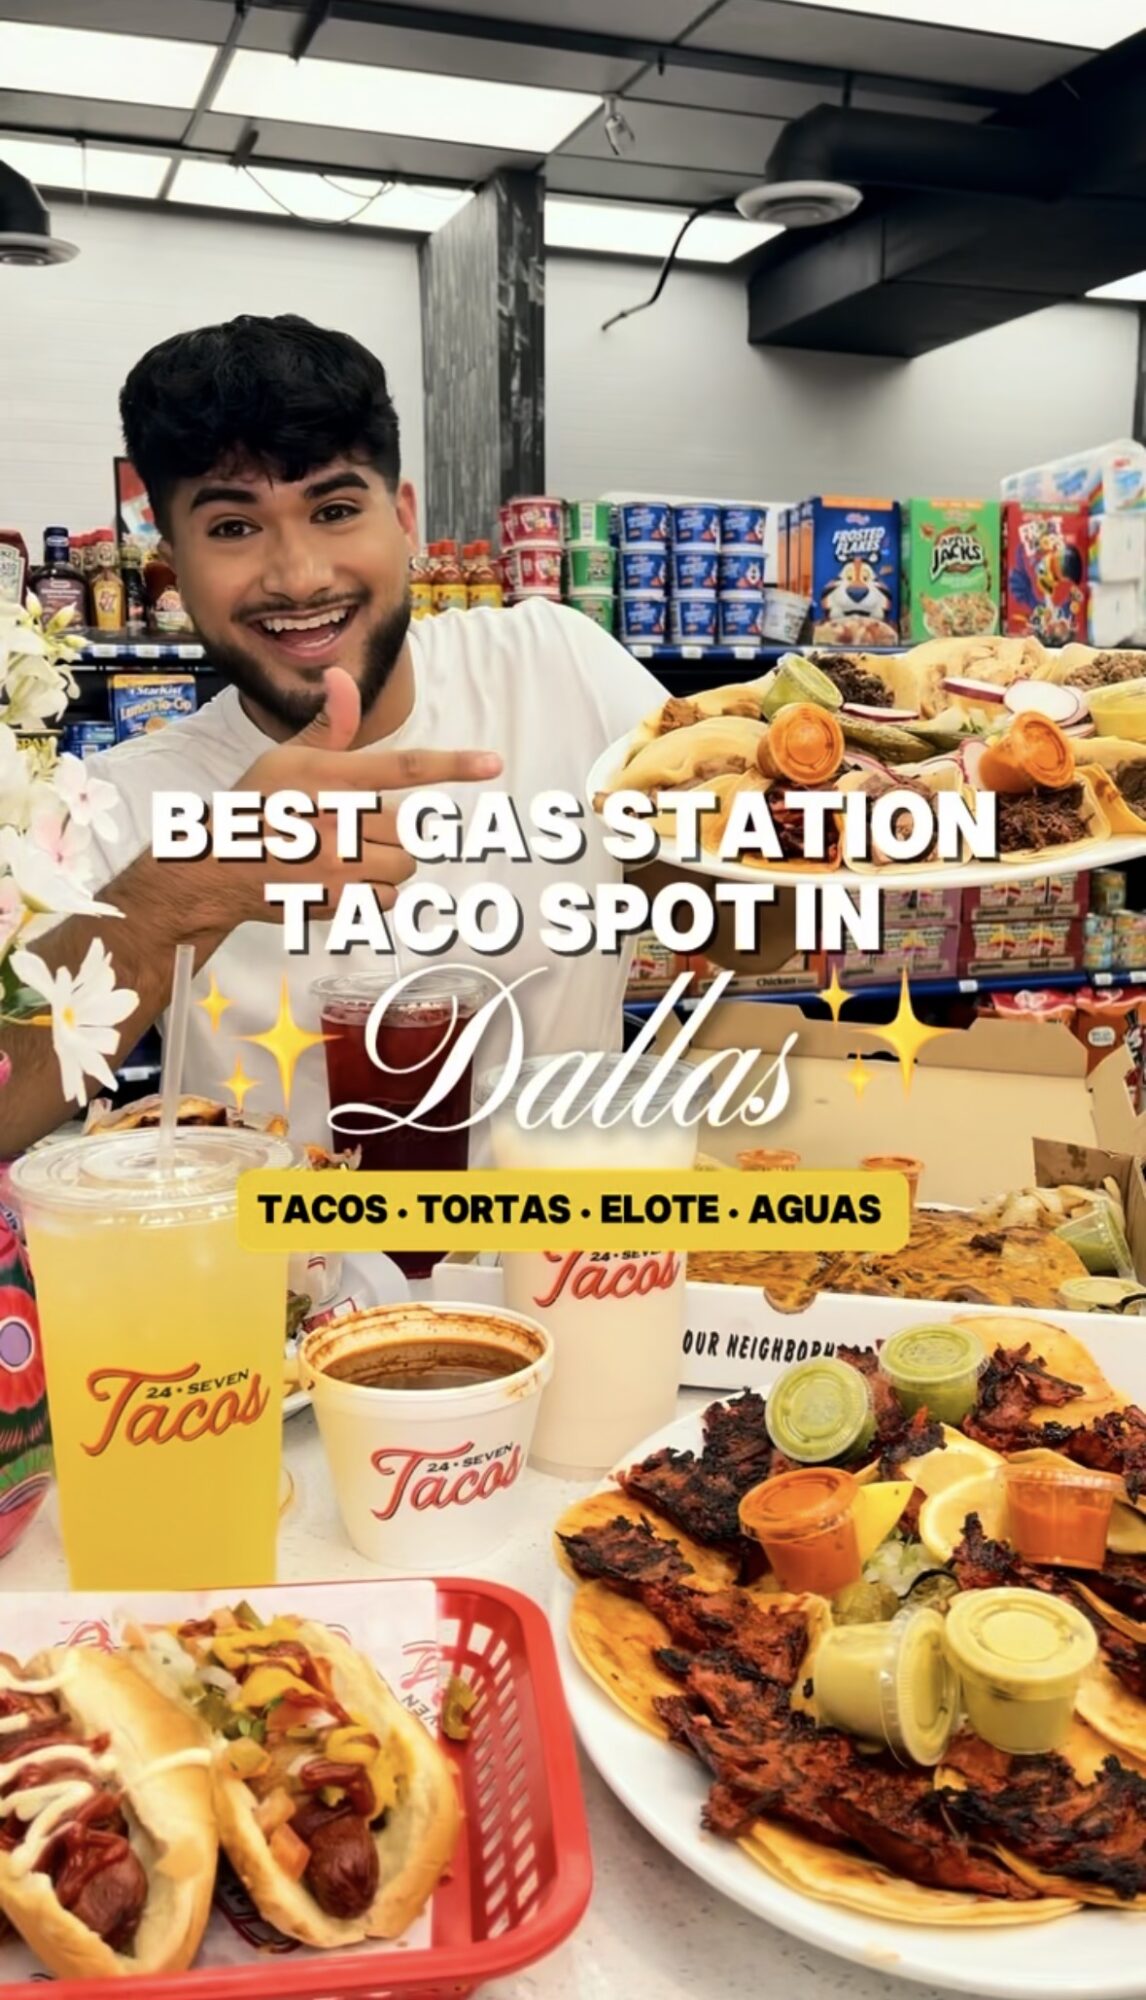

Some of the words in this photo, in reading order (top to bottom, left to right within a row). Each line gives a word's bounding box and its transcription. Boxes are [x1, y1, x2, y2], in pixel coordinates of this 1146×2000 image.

[832, 526, 886, 544] FROSTED
[835, 541, 880, 556] FLAKES
[931, 545, 982, 576] JACKS
[532, 1250, 681, 1308] Tacos
[682, 1328, 720, 1356] OUR
[146, 1387, 172, 1399] 24
[187, 1368, 249, 1395] SEVEN
[79, 1361, 270, 1457] Tacos
[426, 1462, 450, 1473] 24
[462, 1441, 513, 1468] SEVEN
[370, 1440, 523, 1521] Tacos
